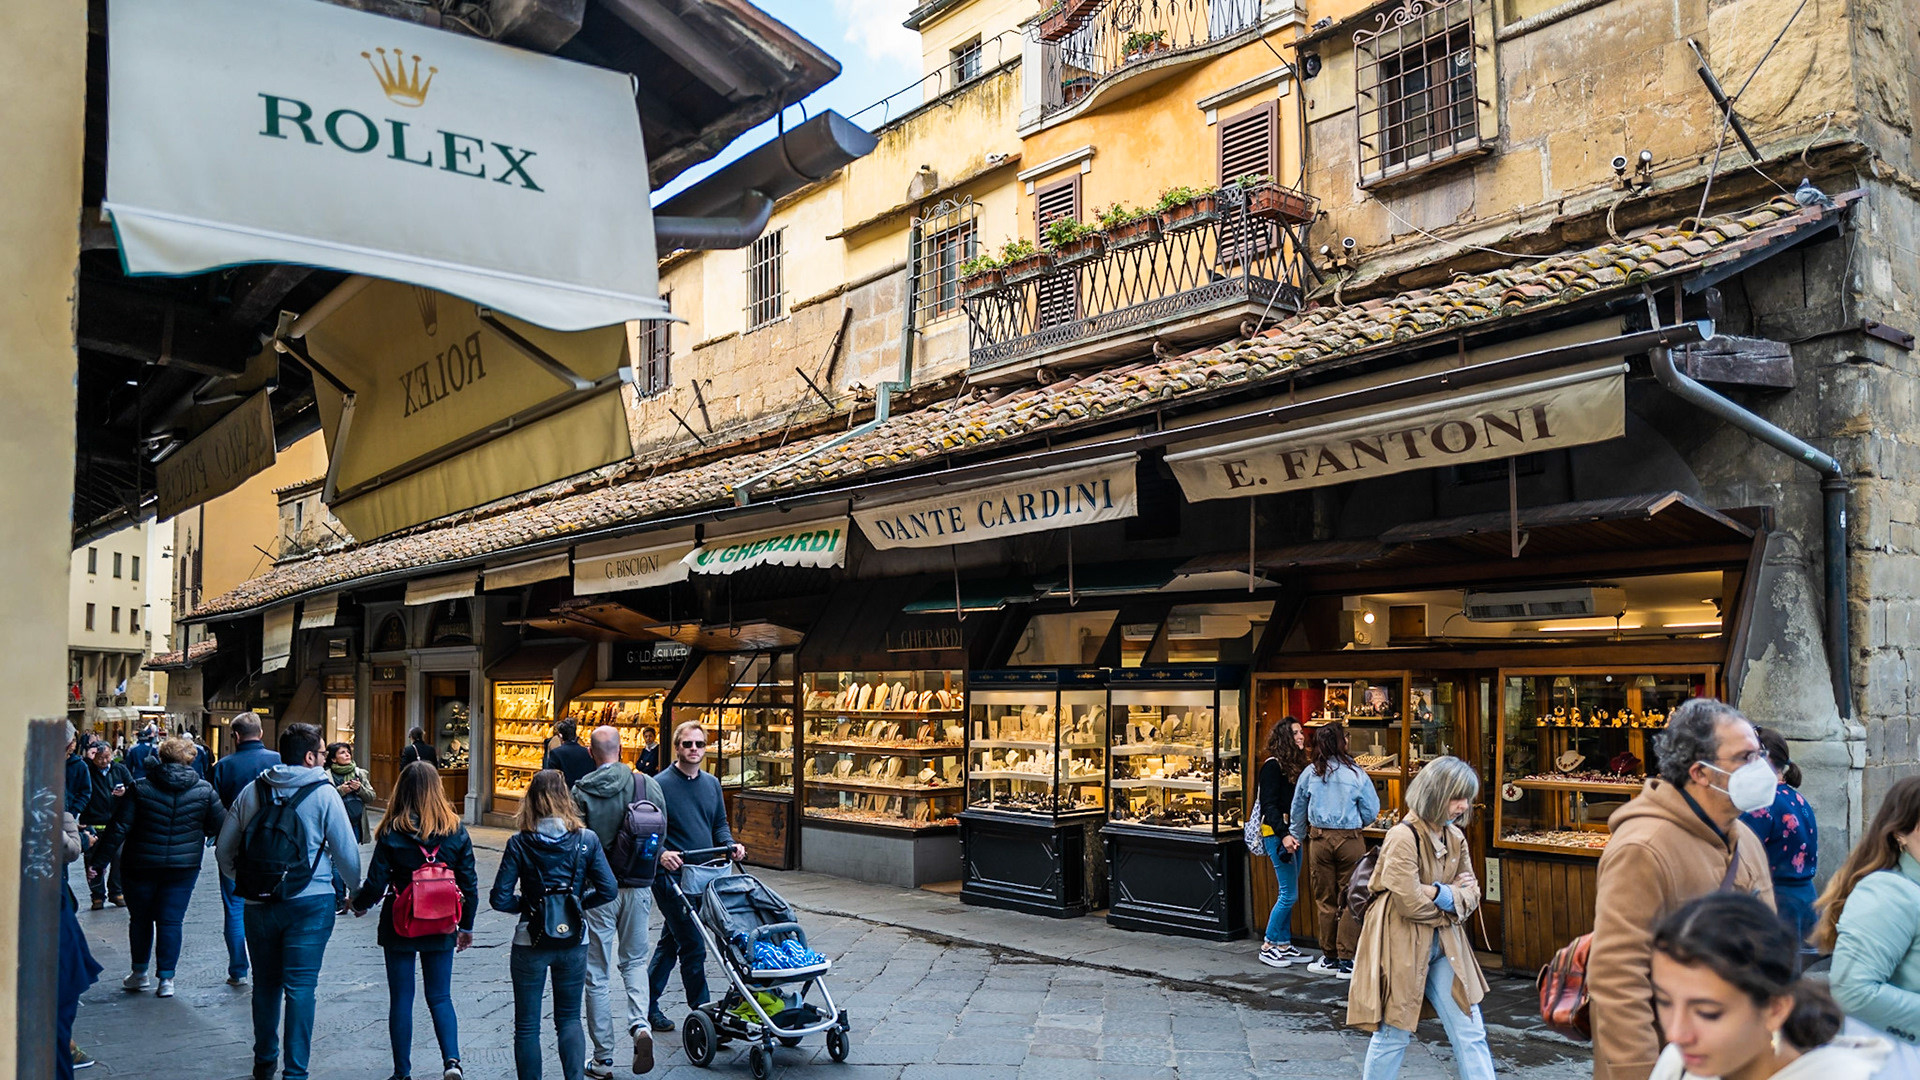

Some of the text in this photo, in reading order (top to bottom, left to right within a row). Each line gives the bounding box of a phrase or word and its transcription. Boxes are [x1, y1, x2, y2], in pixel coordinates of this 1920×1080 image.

[258, 93, 544, 192] ROLEX
[1219, 402, 1556, 490] E. FANTONI
[875, 478, 1114, 541] DANTE CARDINI
[605, 554, 659, 580] G. BISCIONI
[697, 529, 840, 567] U. GHERARDI
[627, 650, 651, 664] GOLD
[901, 628, 963, 649] GHERARDI
